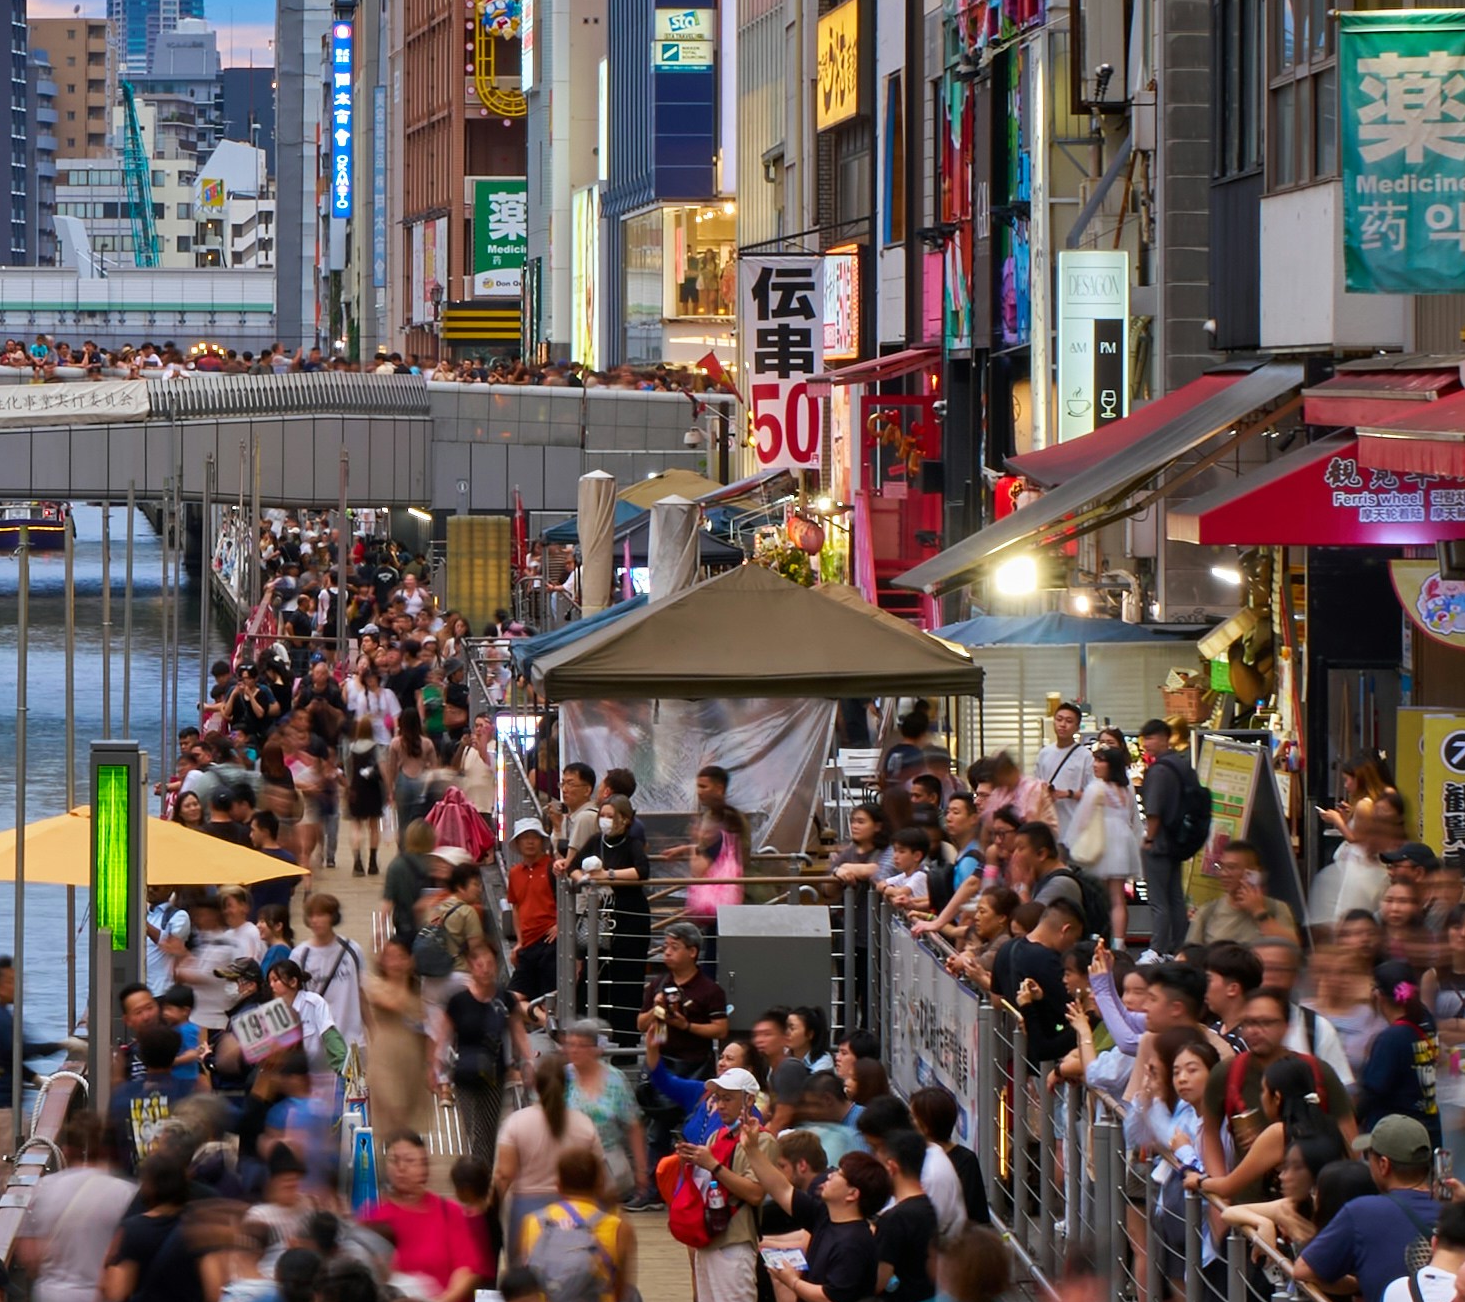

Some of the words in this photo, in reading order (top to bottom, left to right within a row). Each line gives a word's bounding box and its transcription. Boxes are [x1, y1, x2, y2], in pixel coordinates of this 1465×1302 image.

[671, 12, 698, 31] sta
[488, 191, 527, 241] 薬
[496, 278, 511, 290] Don
[1067, 273, 1120, 299] DESAGON
[751, 266, 817, 379] 伝串
[1099, 341, 1117, 354] PM
[751, 381, 820, 465] 50
[1333, 491, 1377, 506] Ferris
[1381, 490, 1423, 506] wheel
[240, 1001, 293, 1045] 19:10
